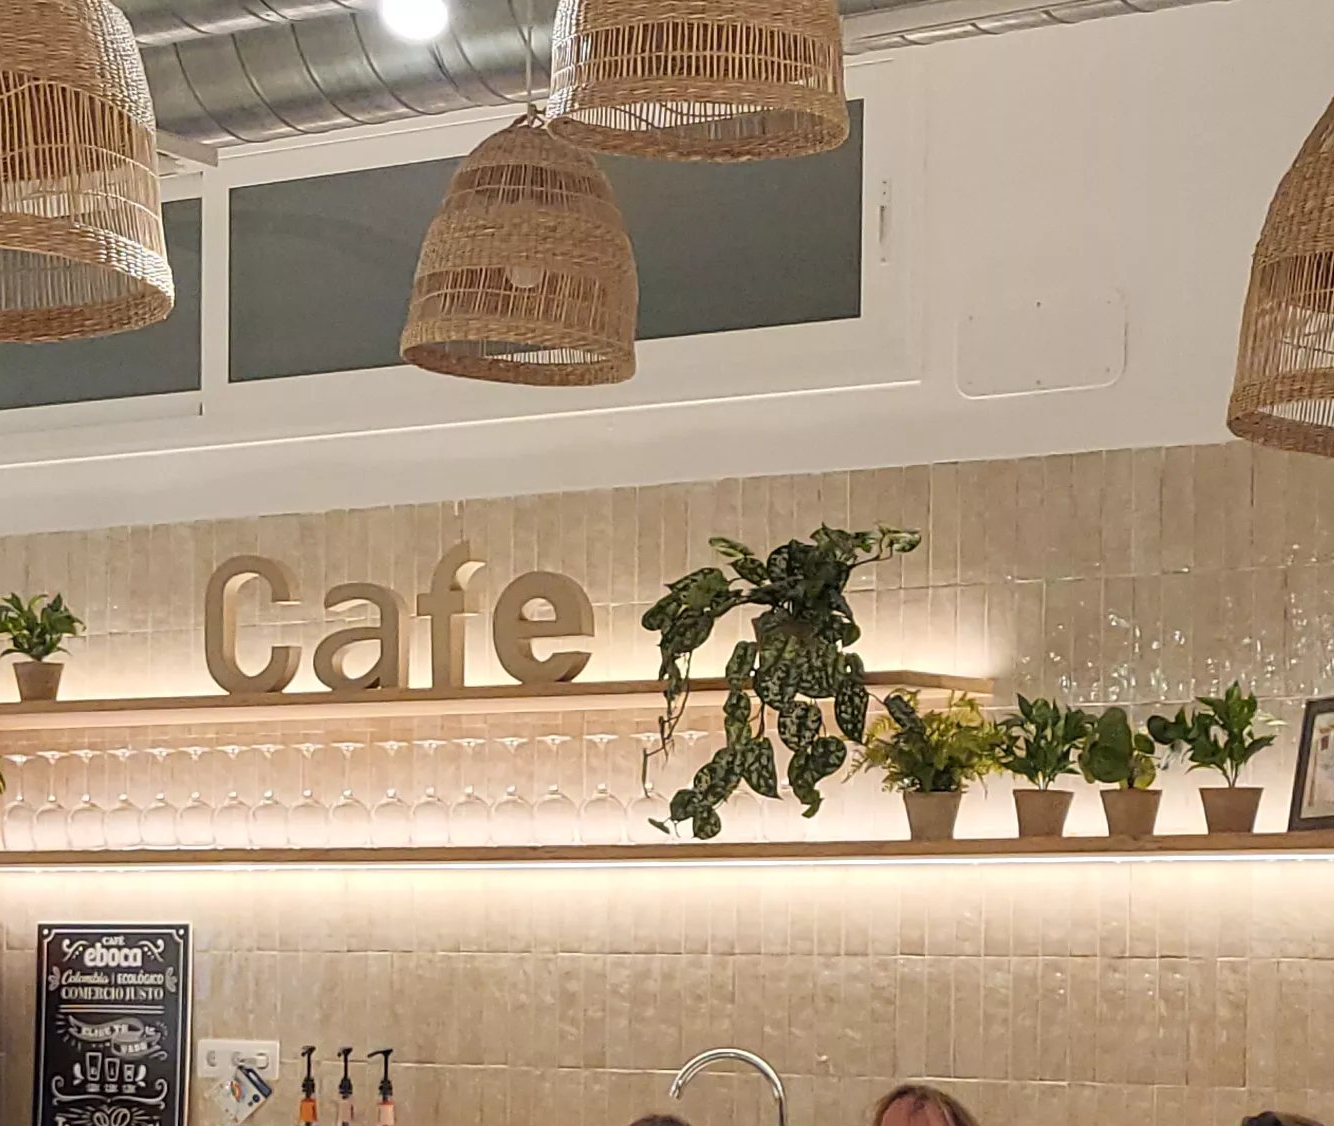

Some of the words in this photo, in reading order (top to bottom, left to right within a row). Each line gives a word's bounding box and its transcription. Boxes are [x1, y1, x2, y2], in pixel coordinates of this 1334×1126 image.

[204, 540, 597, 694] Cafe
[102, 936, 126, 946] CAFÉ
[83, 942, 143, 967] eboca
[61, 968, 109, 985] Colombia
[116, 969, 164, 985] ECOLÓGICO
[60, 986, 124, 1001] COMERCIO
[126, 986, 164, 1001] JUSTO
